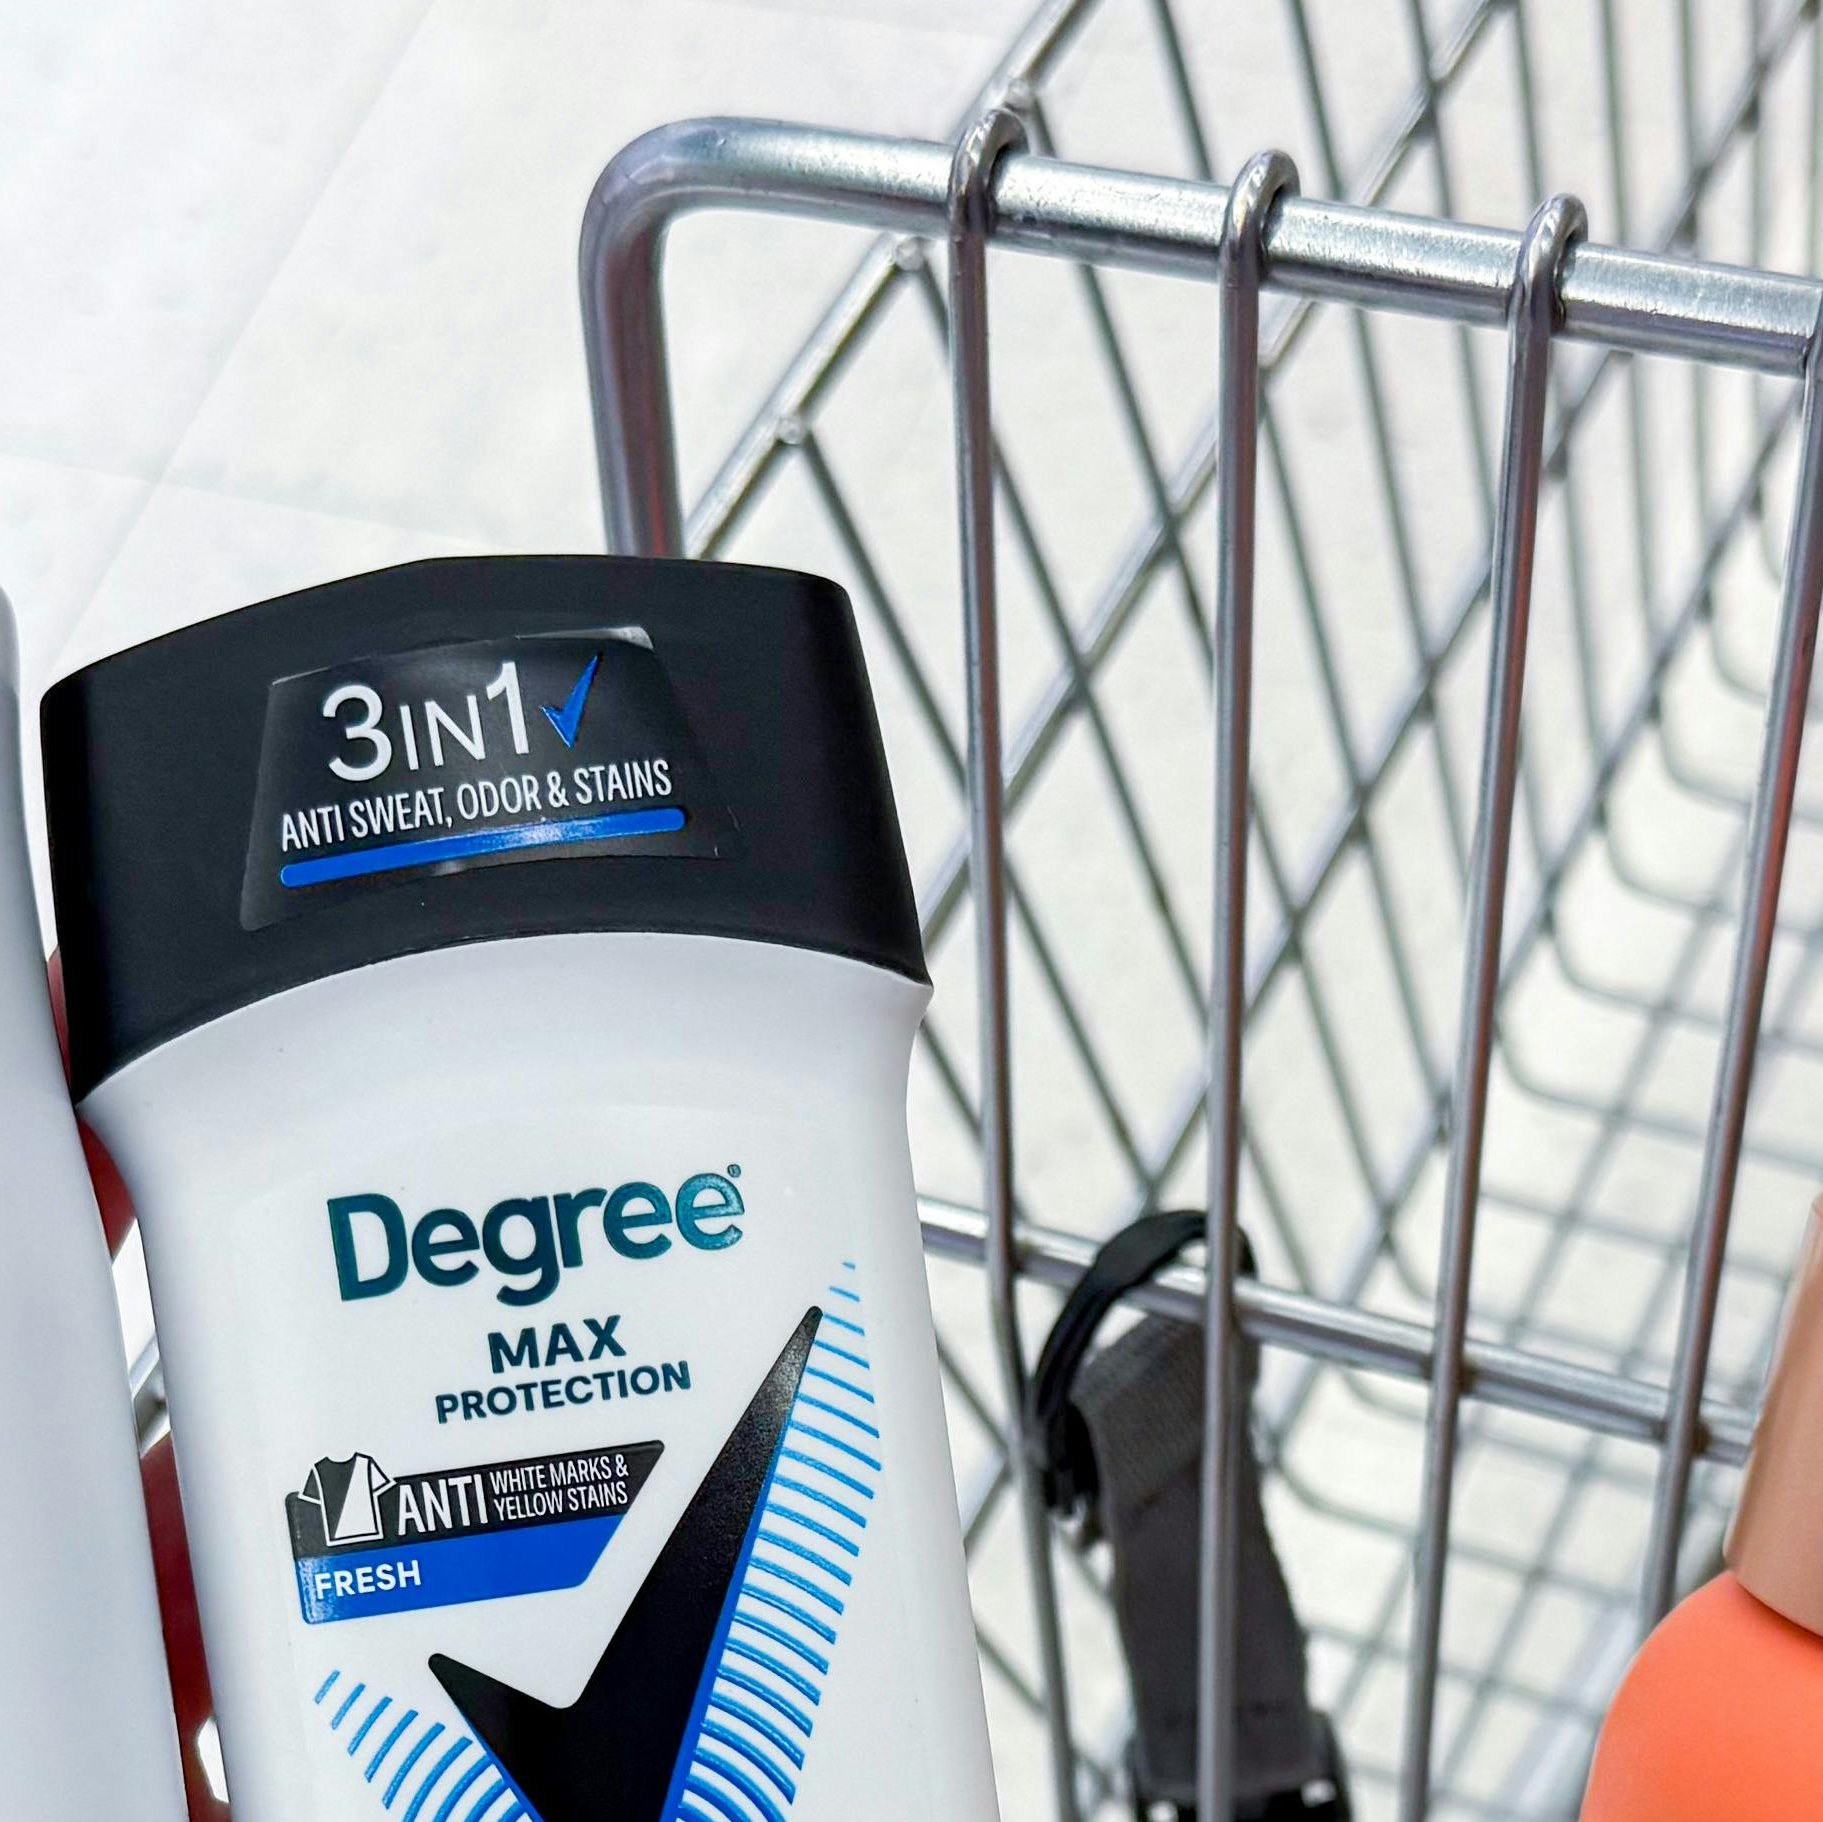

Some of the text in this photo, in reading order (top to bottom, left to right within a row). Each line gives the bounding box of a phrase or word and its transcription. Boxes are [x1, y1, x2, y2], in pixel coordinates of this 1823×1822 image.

[282, 759, 673, 852] ANTI SWEAT, ODOR & STAINS
[327, 1170, 745, 1306] Degree
[487, 1314, 627, 1374] MAX
[436, 1360, 692, 1424] PROTECTION
[490, 1454, 629, 1495] WHITE MARKS &
[494, 1481, 628, 1521] YELLOW STAINS
[398, 1475, 488, 1536] ANTI
[315, 1560, 422, 1600] FRESH
